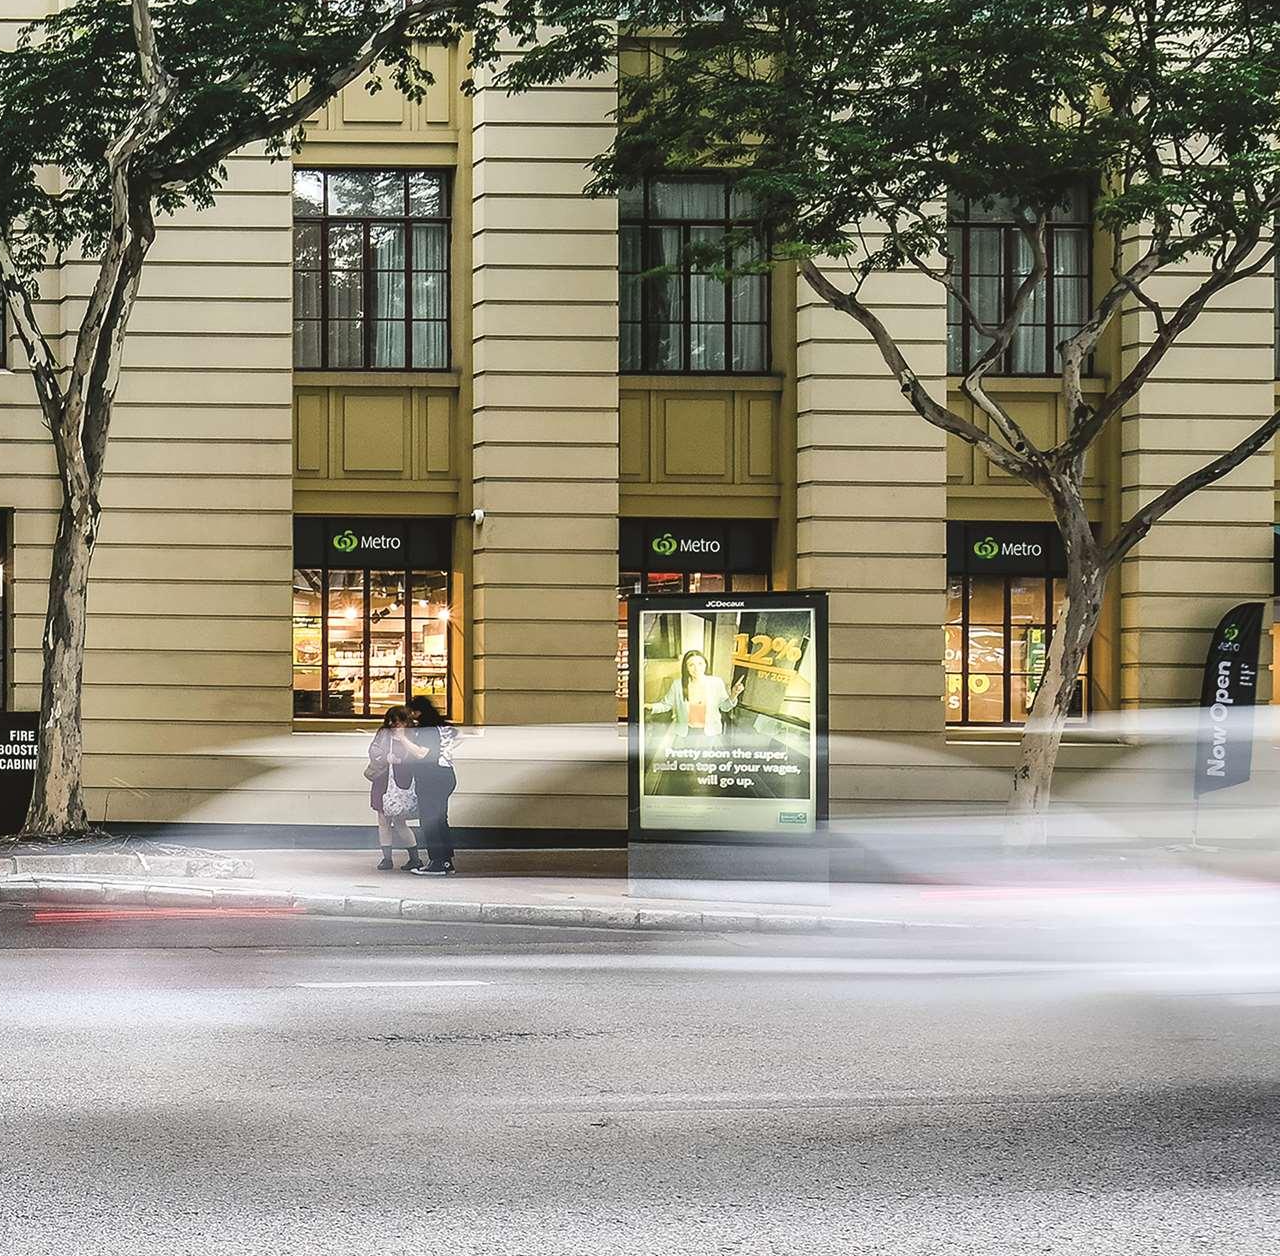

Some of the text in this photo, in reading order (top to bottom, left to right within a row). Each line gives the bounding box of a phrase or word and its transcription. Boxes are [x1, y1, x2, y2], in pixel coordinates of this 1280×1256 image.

[361, 535, 401, 549] Metro
[680, 538, 721, 553] Metro
[1001, 542, 1042, 556] Metro
[733, 633, 802, 665] 12%
[1207, 660, 1234, 777] Now Open
[10, 730, 35, 742] FIRE
[665, 748, 788, 762] Pretty soon the super,
[653, 760, 801, 776] paid on top of your wages,
[697, 775, 755, 788] will go up.
